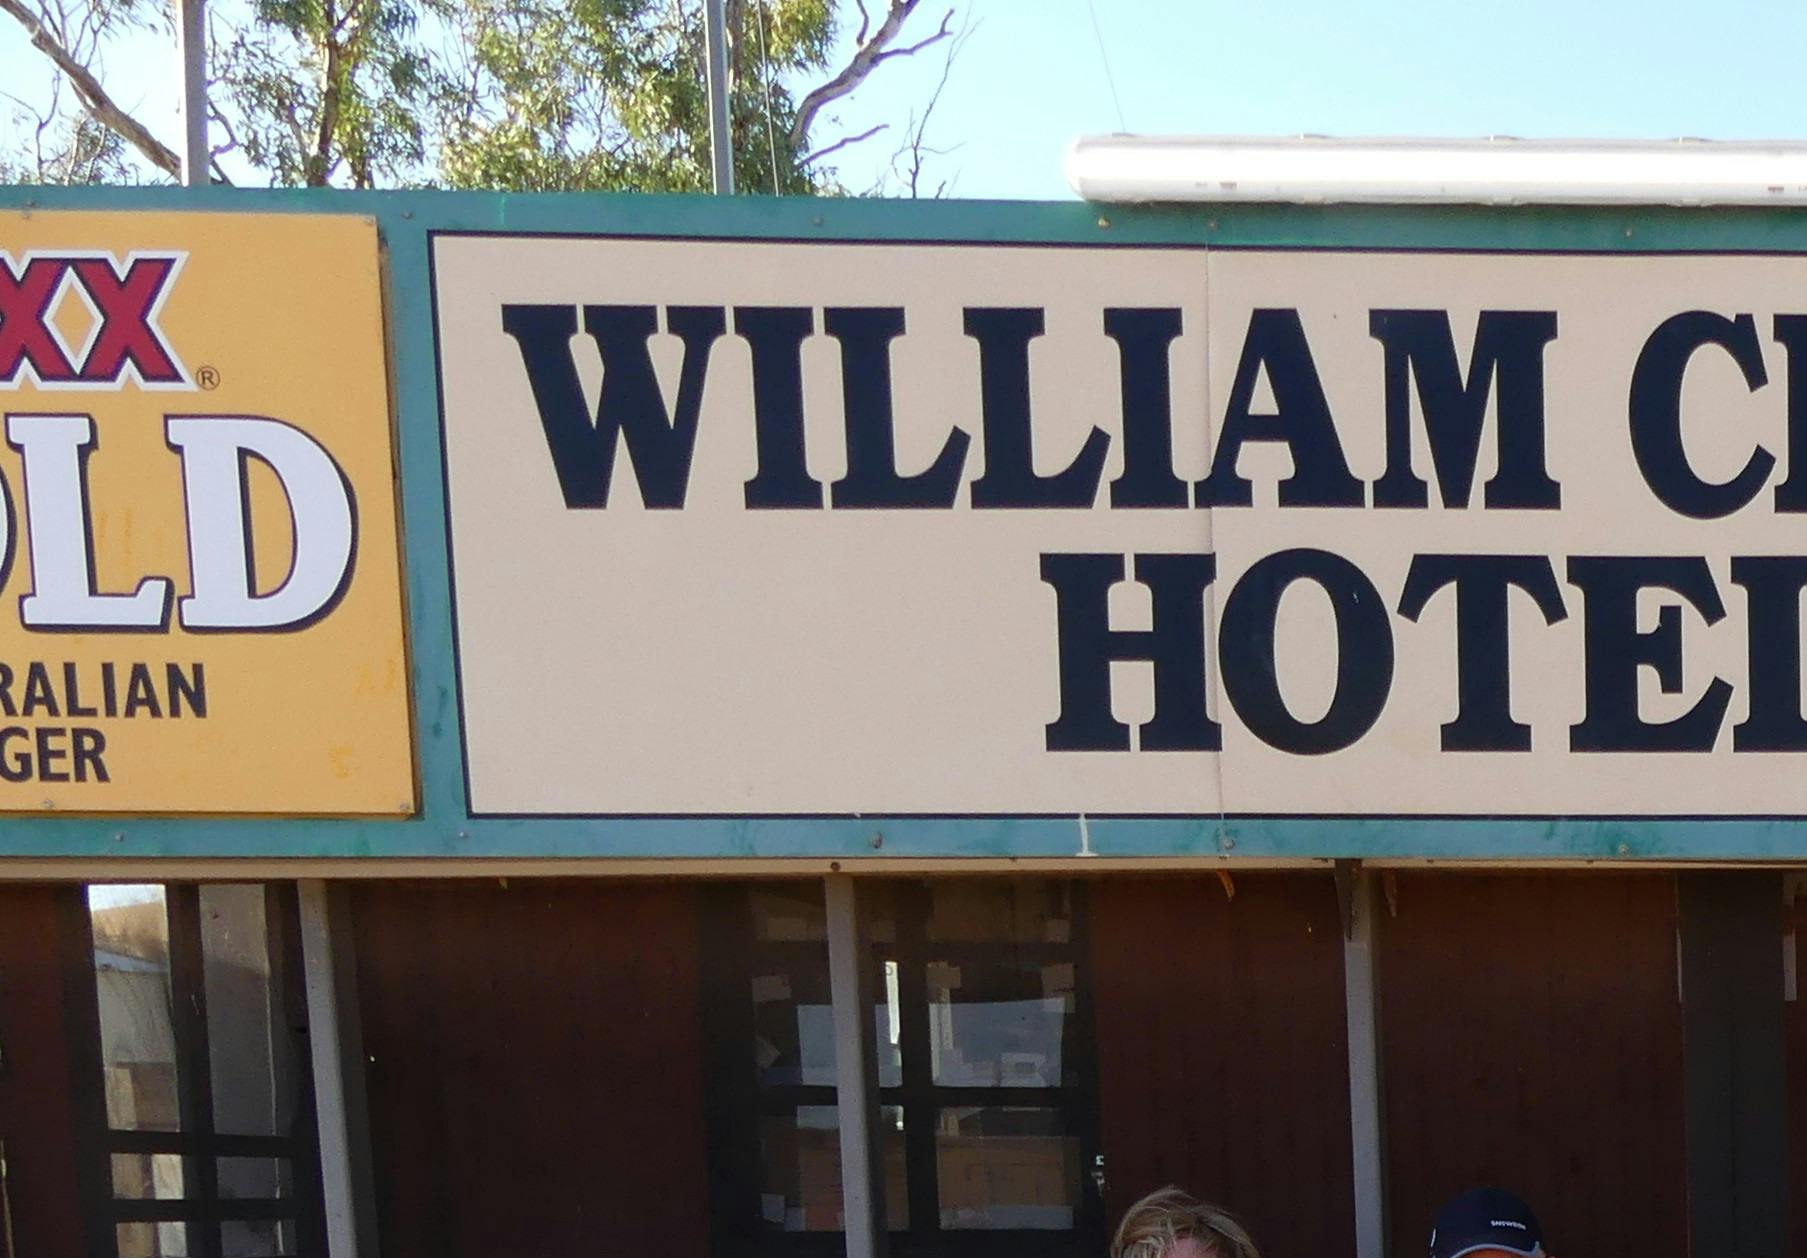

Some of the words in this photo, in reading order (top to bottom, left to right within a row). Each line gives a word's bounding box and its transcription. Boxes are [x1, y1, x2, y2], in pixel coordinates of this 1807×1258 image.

[501, 303, 1562, 511] WILLIAM
[0, 412, 358, 634] LD
[0, 726, 110, 783] GER
